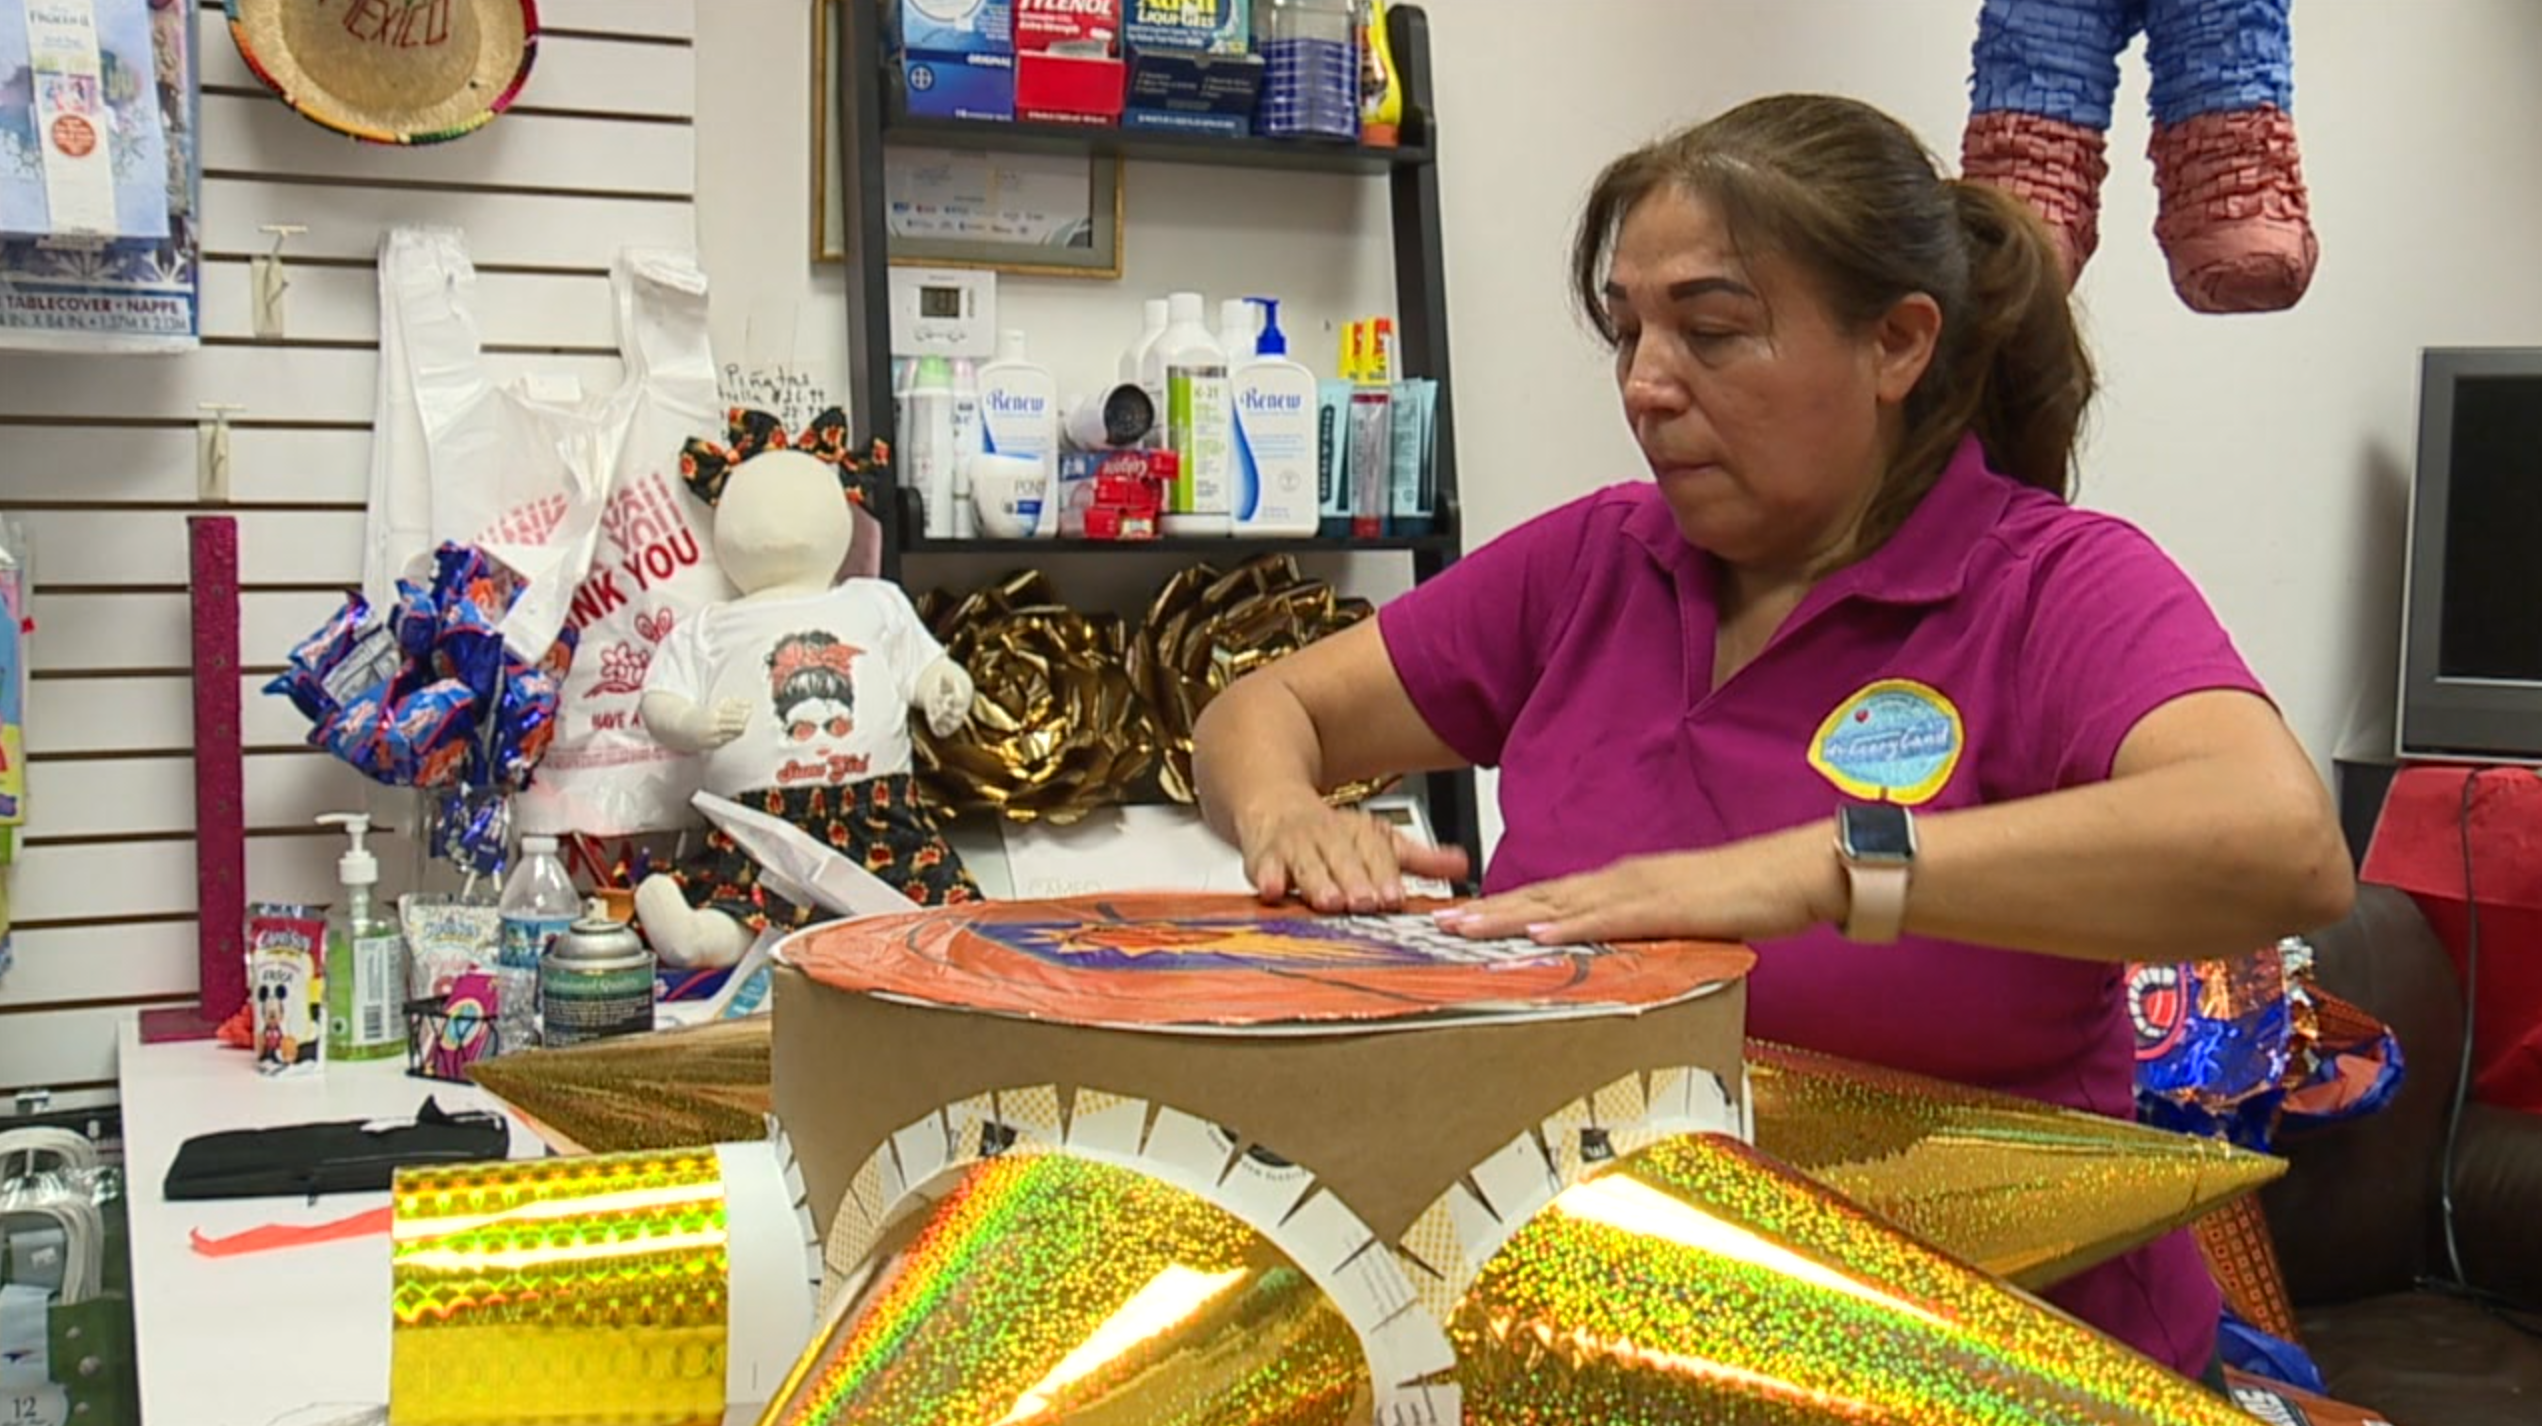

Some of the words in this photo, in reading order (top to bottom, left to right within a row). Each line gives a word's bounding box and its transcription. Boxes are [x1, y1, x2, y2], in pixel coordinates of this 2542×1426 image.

[6, 295, 111, 313] TABLECOVER
[127, 299, 179, 315] NAPPE
[987, 389, 1046, 413] Renew
[1240, 387, 1302, 410] Renew
[622, 527, 700, 592] YOU
[12, 1396, 37, 1418] 12
